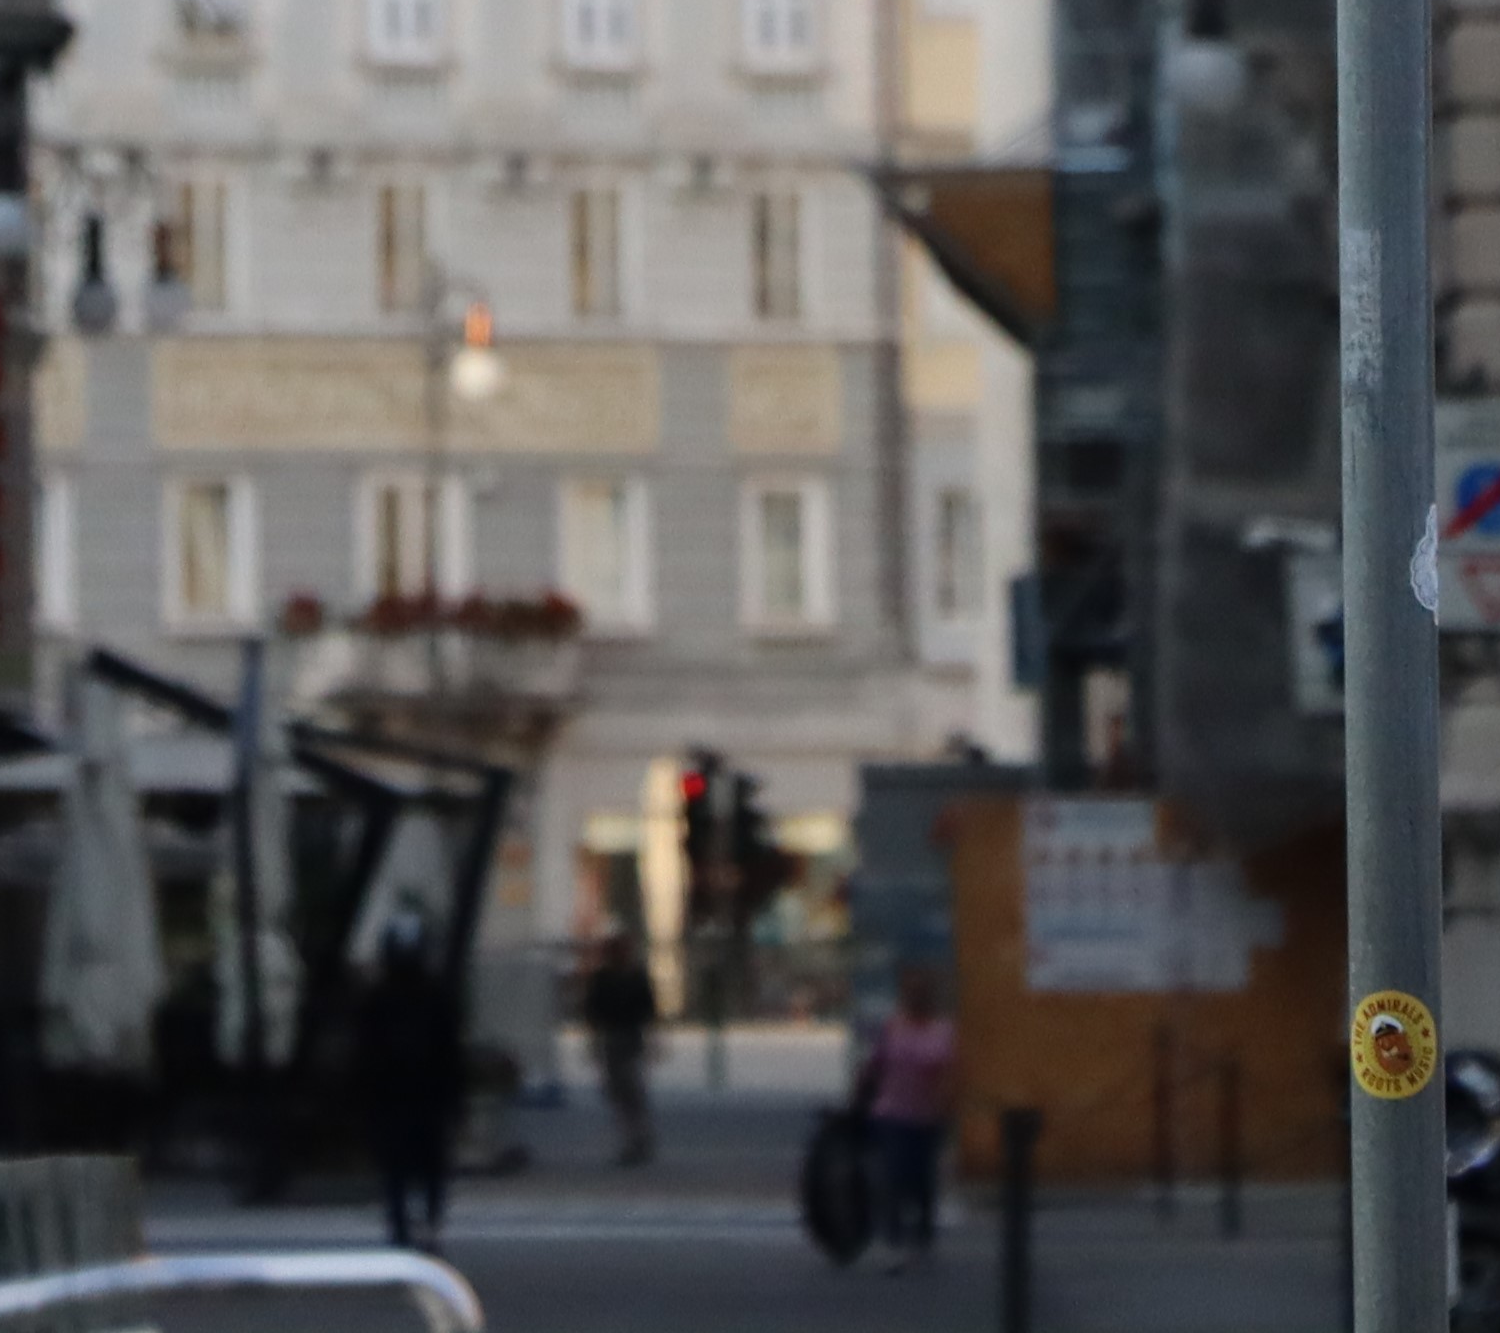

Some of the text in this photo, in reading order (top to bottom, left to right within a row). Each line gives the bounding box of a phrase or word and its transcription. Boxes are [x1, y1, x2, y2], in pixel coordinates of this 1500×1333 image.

[1354, 999, 1424, 1045] THE ADMIRALS
[1362, 1046, 1433, 1092] ROOTS MUSIC
